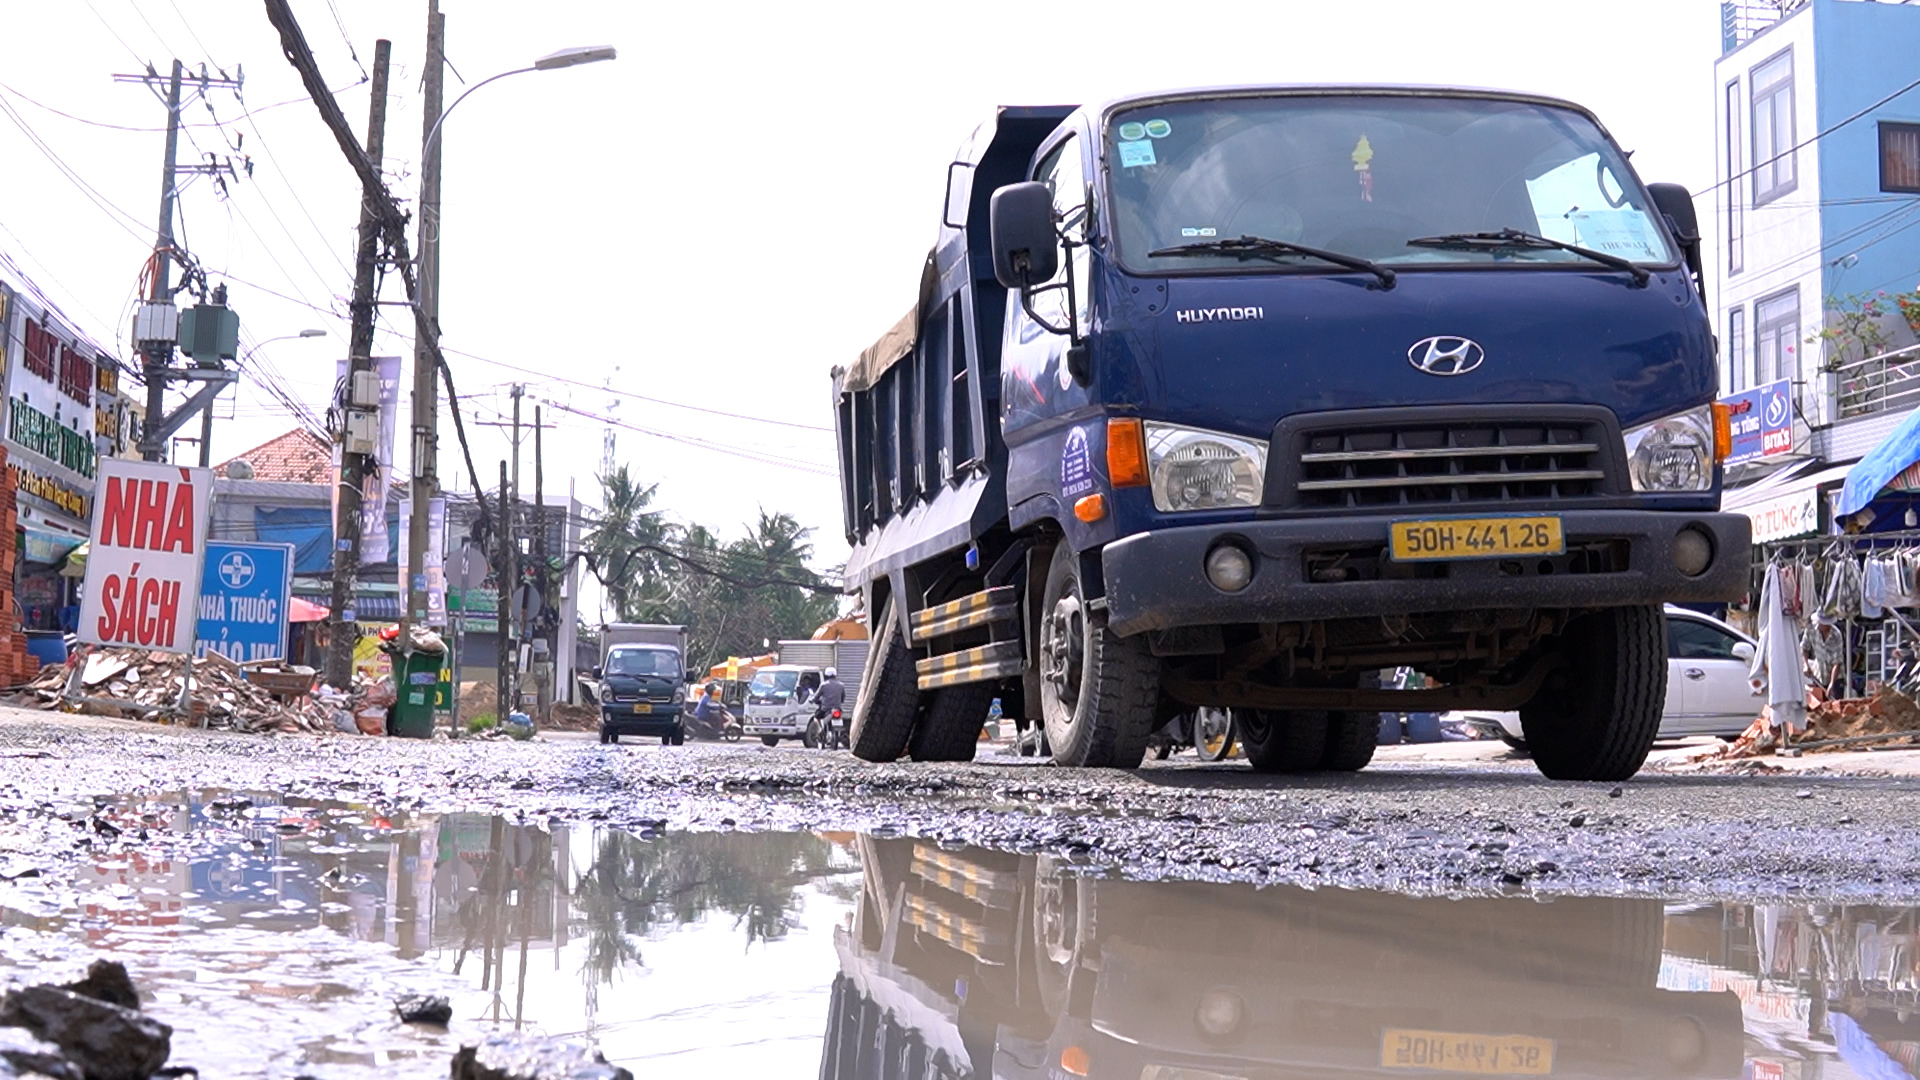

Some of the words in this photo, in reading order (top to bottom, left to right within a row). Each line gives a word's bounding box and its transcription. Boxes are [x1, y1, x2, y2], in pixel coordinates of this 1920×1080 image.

[1175, 307, 1265, 323] HUYNDAI
[1763, 429, 1790, 451] BITA'S
[100, 468, 194, 554] NHÀ
[1406, 523, 1550, 552] 50H-441.26
[97, 562, 181, 647] SÁCH
[197, 590, 226, 621] NHÀ
[230, 589, 277, 625] THUỐC
